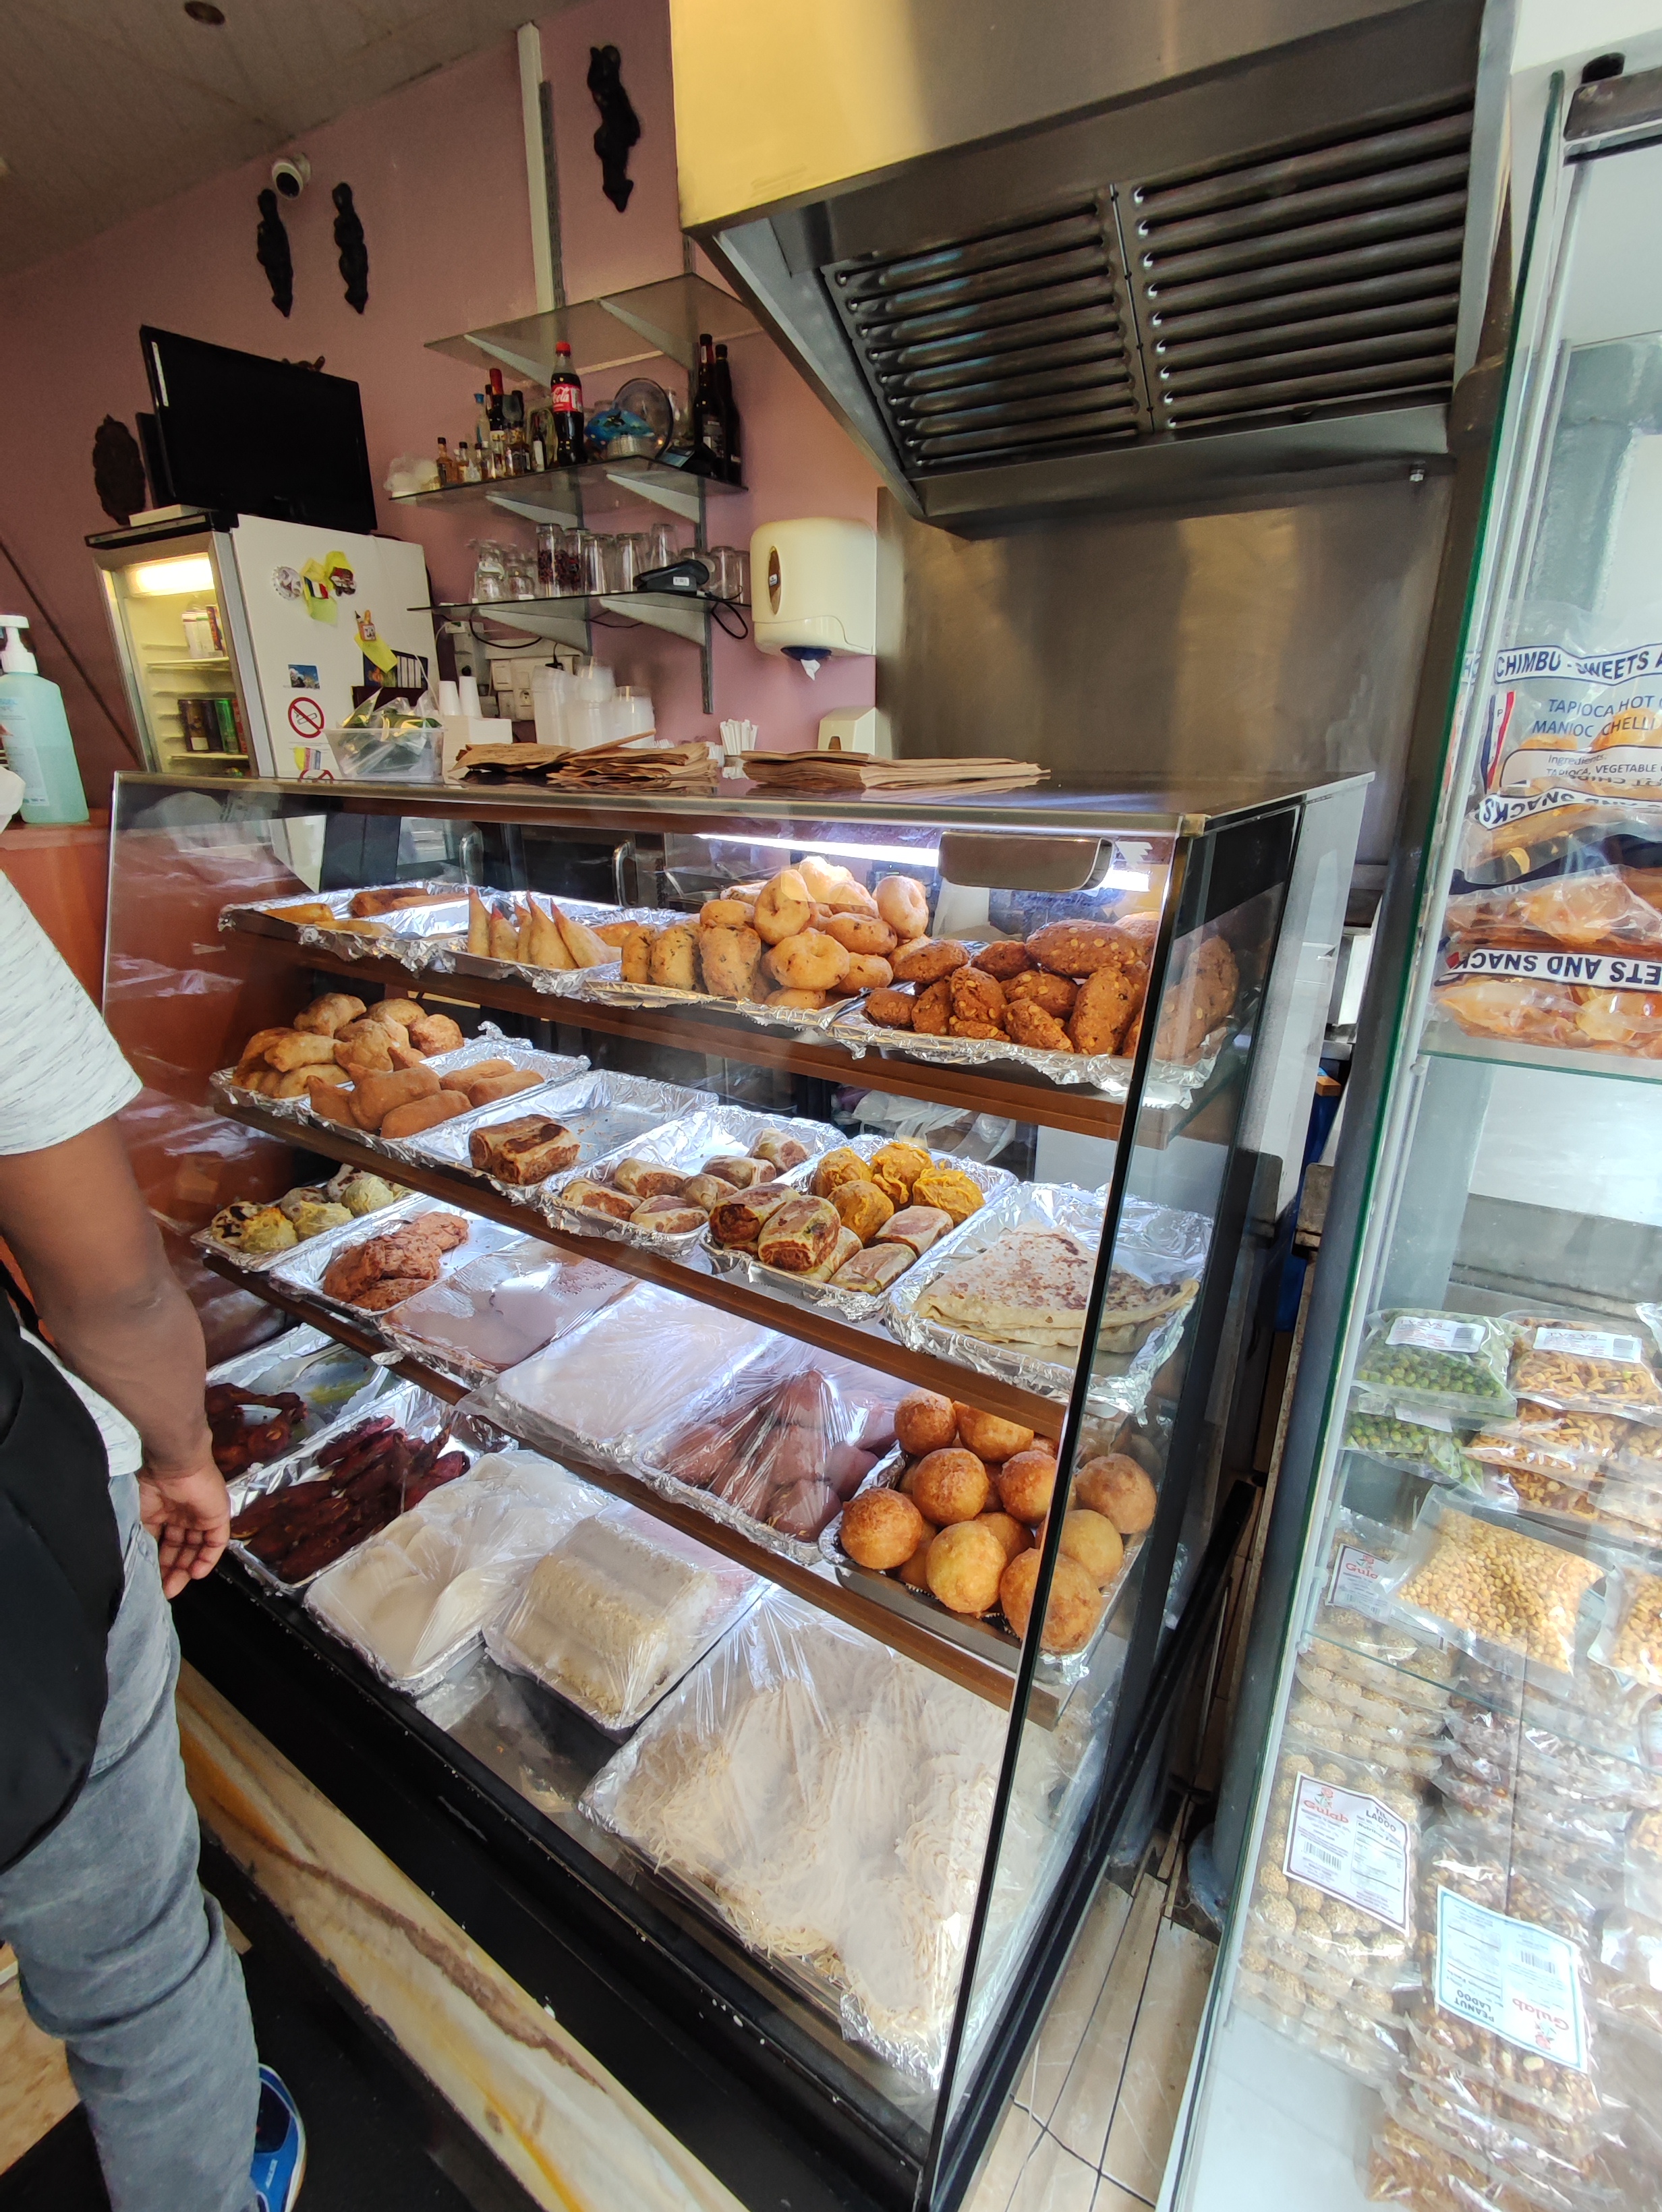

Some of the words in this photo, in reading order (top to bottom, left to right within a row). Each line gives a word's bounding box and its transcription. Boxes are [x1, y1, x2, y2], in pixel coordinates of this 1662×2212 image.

[1496, 651, 1561, 678] CHIMBU
[1549, 699, 1614, 718] TAPIOCA
[1619, 695, 1655, 713] HOT
[1532, 720, 1595, 738] MANIOC
[1595, 763, 1657, 774] VEGETABLE
[1547, 956, 1601, 979] AND
[1303, 1800, 1349, 1824] Gulab
[1366, 1809, 1396, 1832] LADOO
[1454, 1997, 1495, 2022] PEANUT
[1457, 1989, 1491, 2012] LADOO
[1512, 1998, 1570, 2031] Gulab
